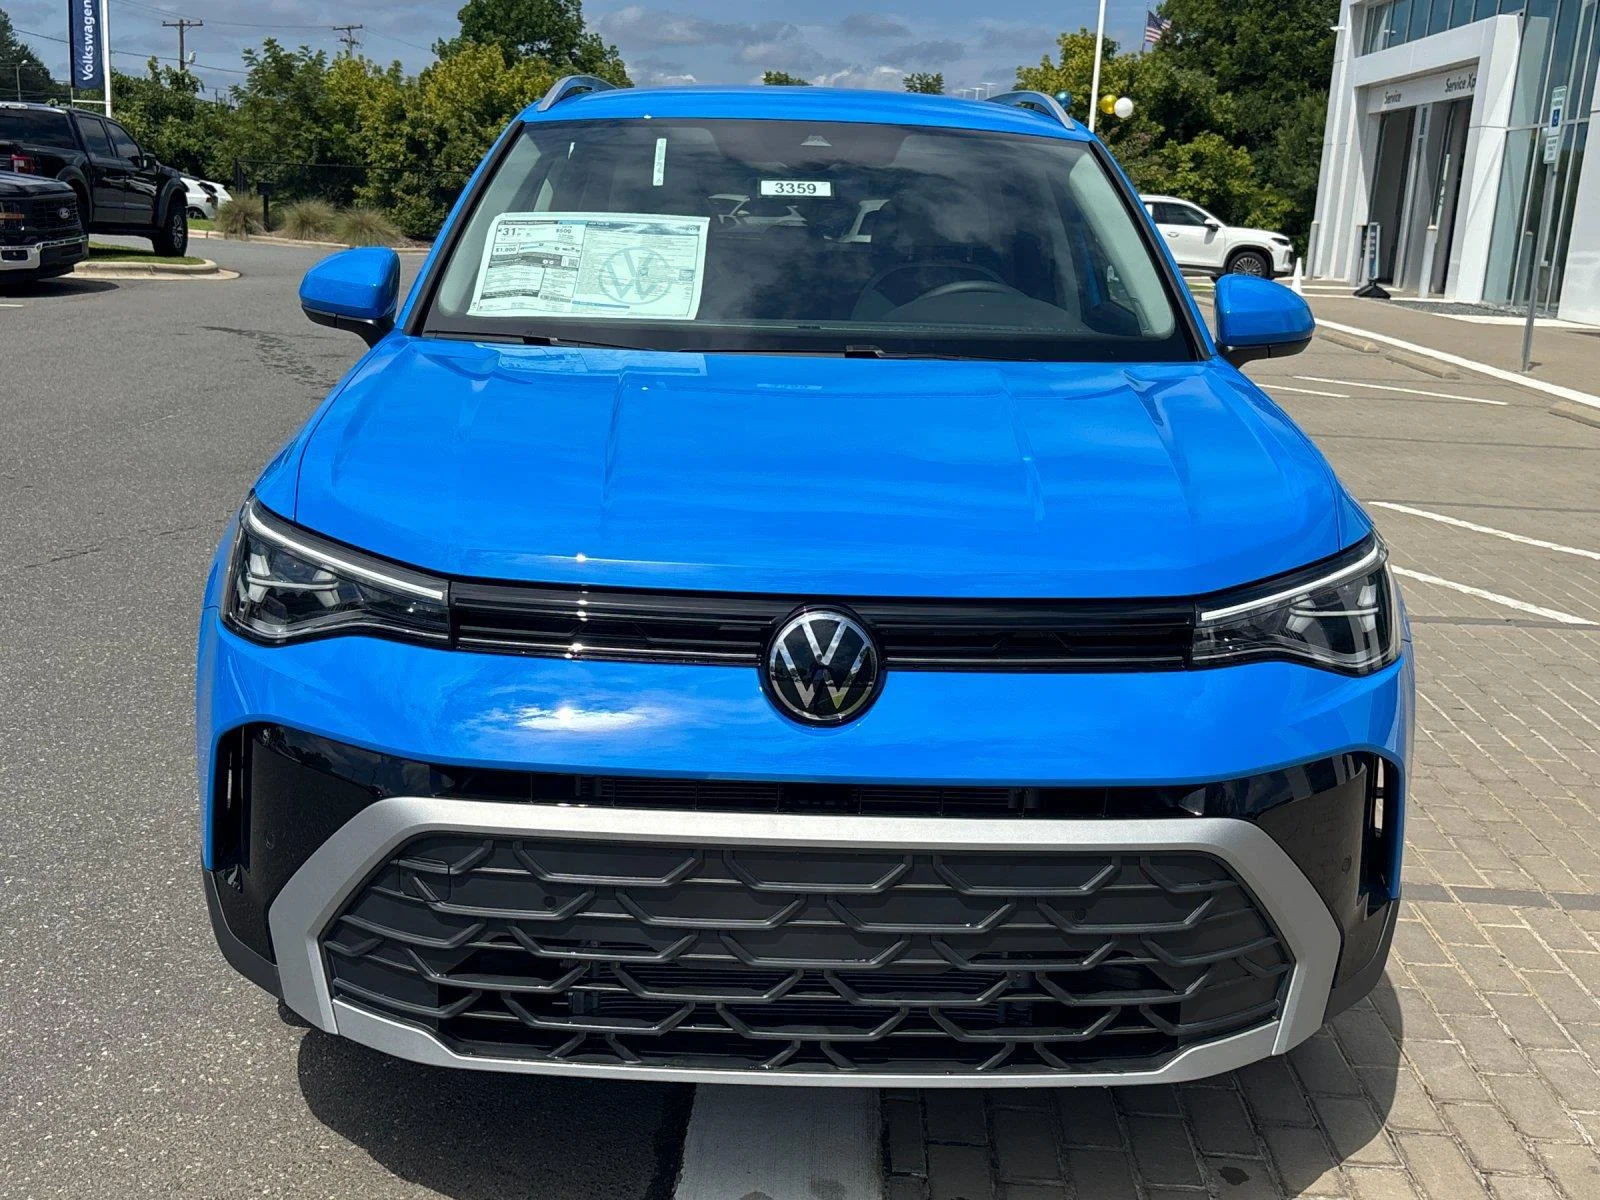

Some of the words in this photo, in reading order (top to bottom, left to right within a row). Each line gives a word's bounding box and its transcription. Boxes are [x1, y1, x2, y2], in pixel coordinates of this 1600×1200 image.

[82, 0, 95, 81] Volkswagen
[1445, 76, 1467, 93] Service
[1384, 90, 1402, 105] Service
[774, 182, 817, 199] 3359
[502, 227, 516, 236] 31
